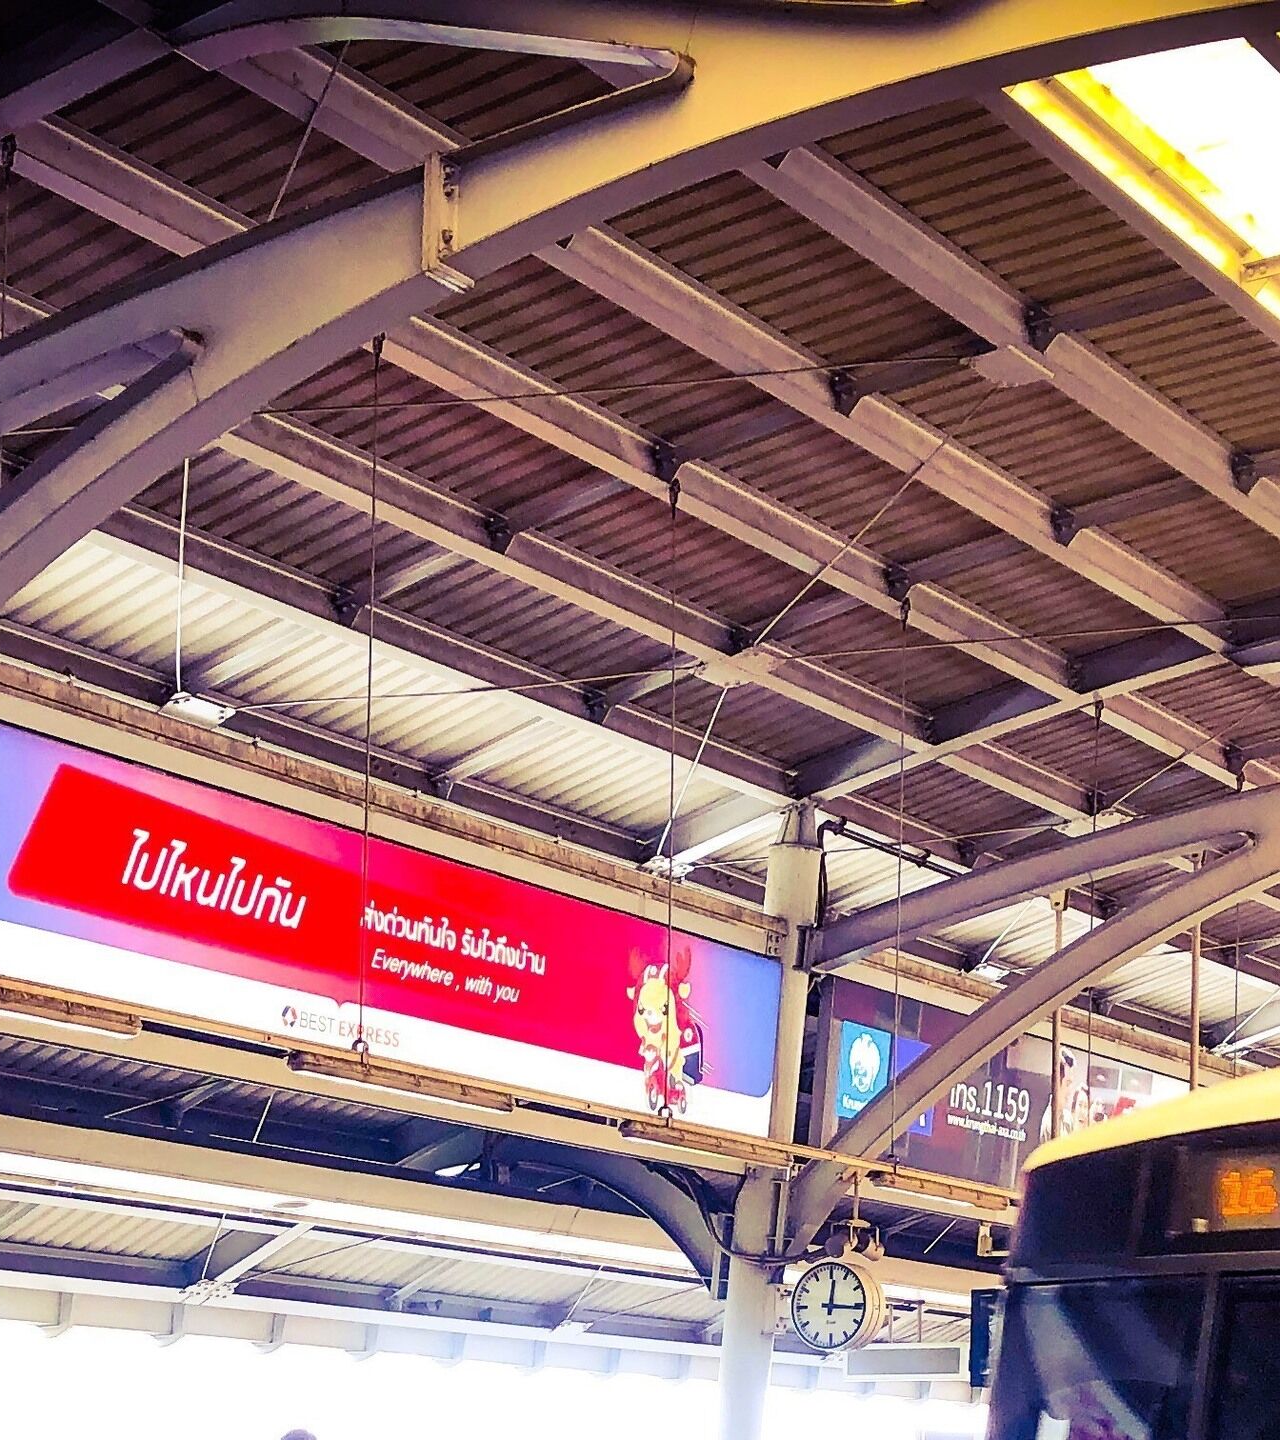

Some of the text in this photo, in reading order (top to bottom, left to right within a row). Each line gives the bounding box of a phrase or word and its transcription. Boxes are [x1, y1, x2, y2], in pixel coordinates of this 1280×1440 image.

[121, 828, 307, 929] ไปไหนไปกัน
[371, 948, 454, 987] Everywhere
[465, 974, 492, 997] with
[495, 985, 521, 1004] you
[299, 1010, 400, 1048] BEST EXPRESS
